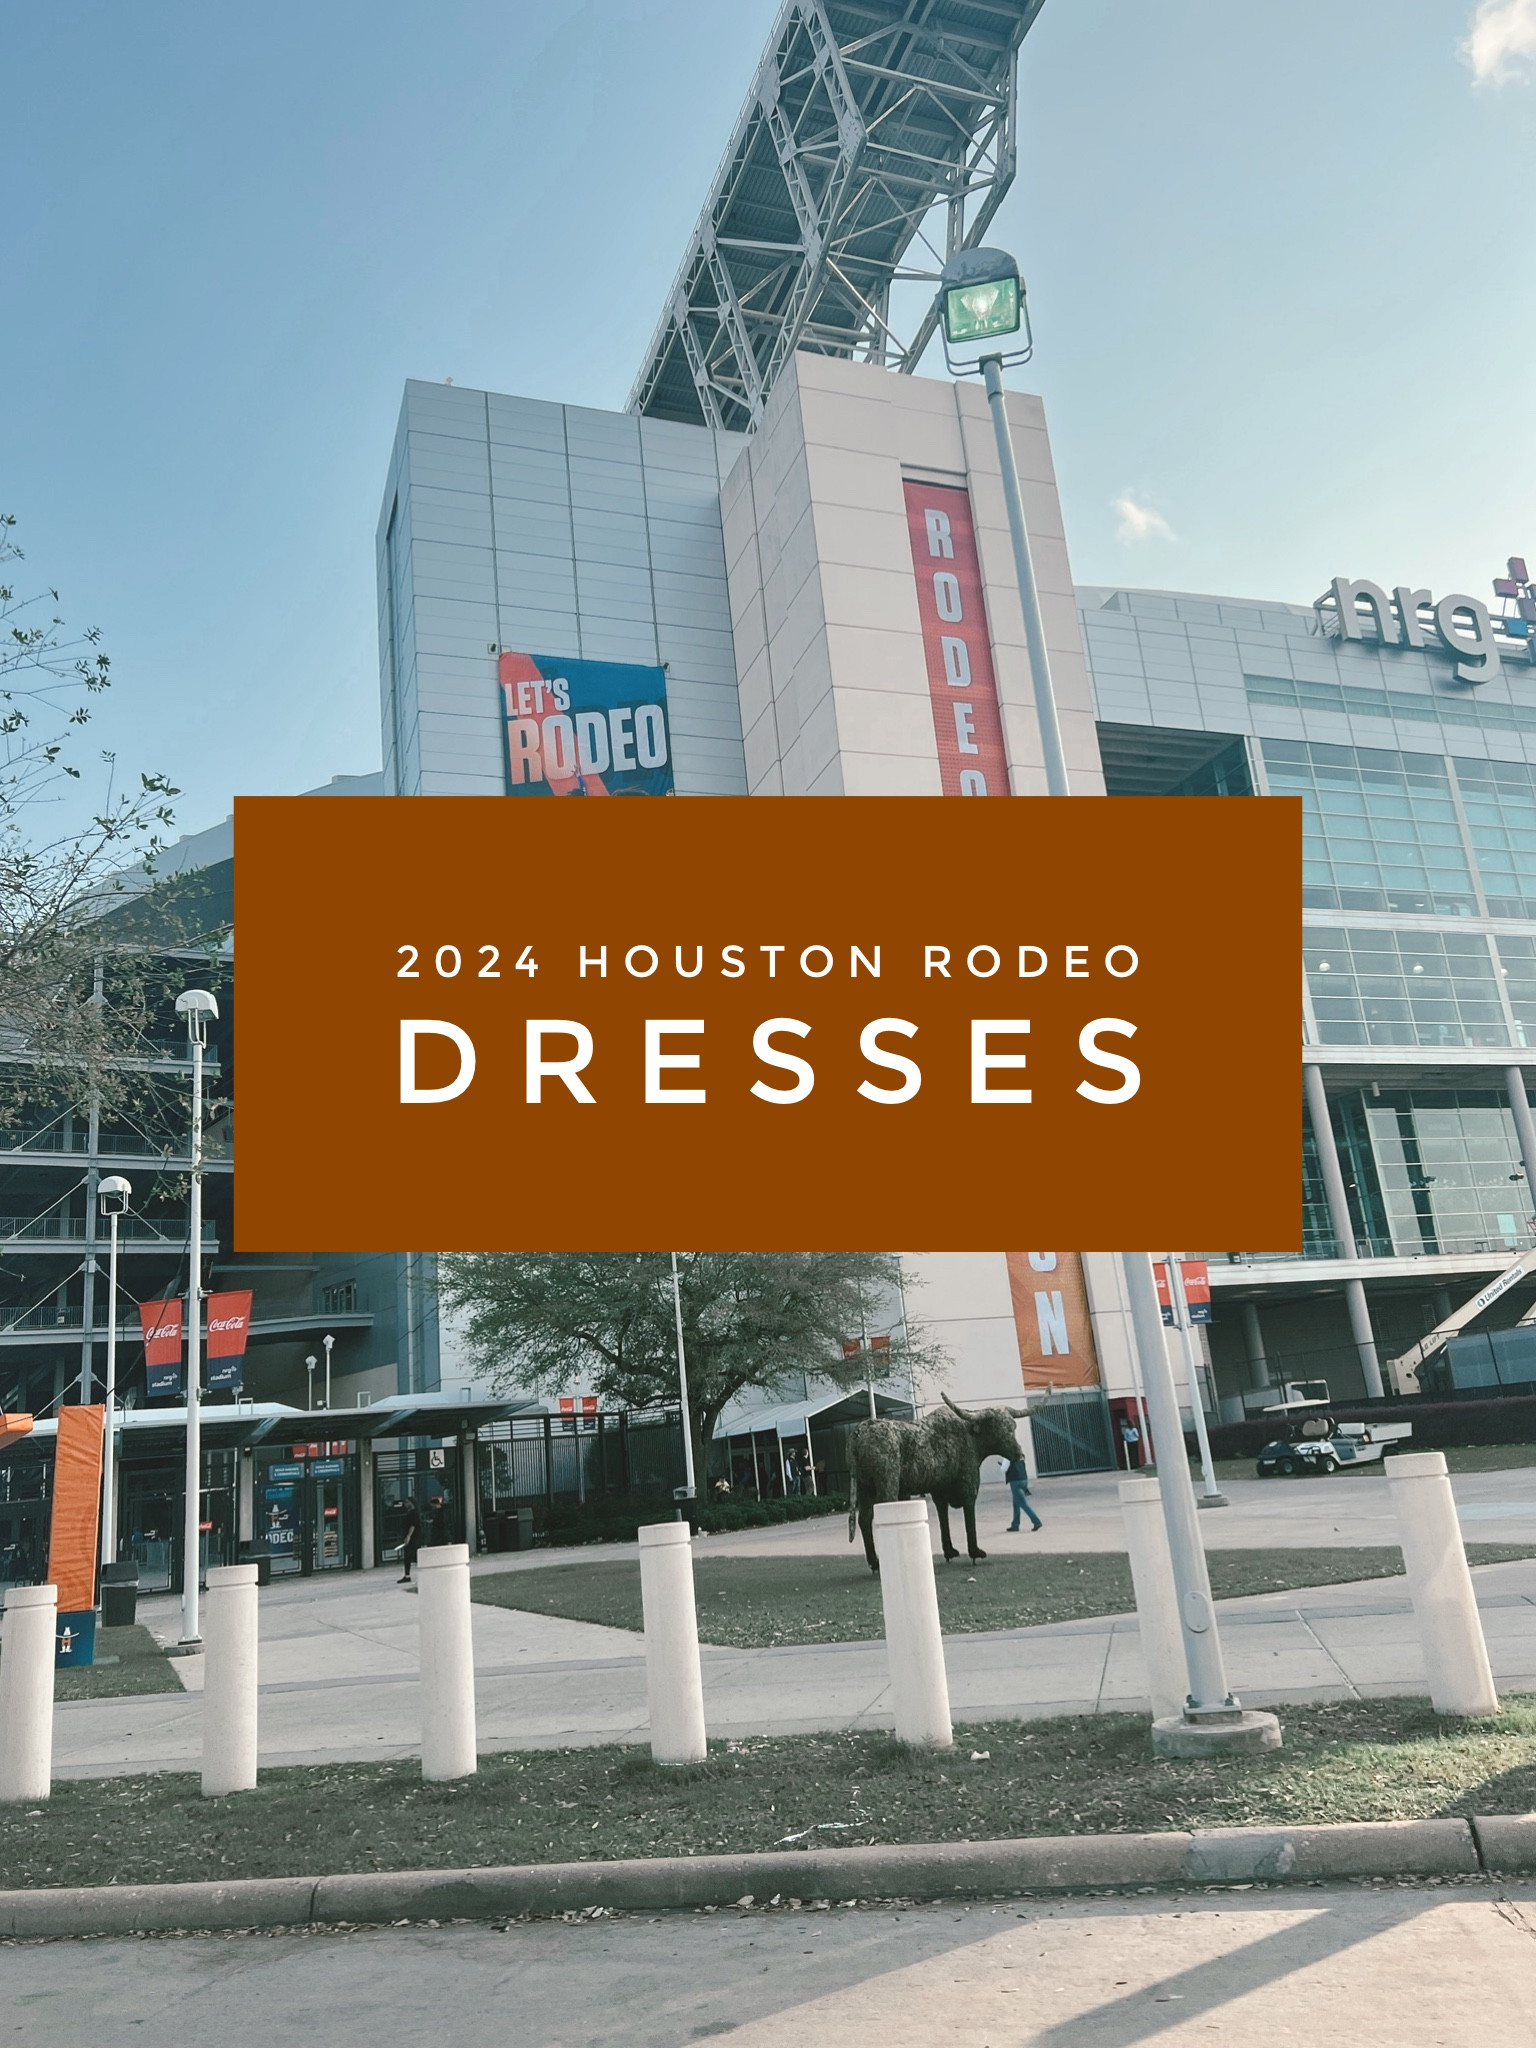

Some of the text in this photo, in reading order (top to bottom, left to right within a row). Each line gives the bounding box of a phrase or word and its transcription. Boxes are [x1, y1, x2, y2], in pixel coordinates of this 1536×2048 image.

[1331, 577, 1500, 685] nrg
[504, 678, 571, 717] LET'S
[507, 704, 668, 785] RODEO
[1484, 1269, 1523, 1302] United Rentals
[209, 1316, 246, 1332] Coca-Cola
[151, 1380, 173, 1388] stadium
[210, 1373, 232, 1381] stadium
